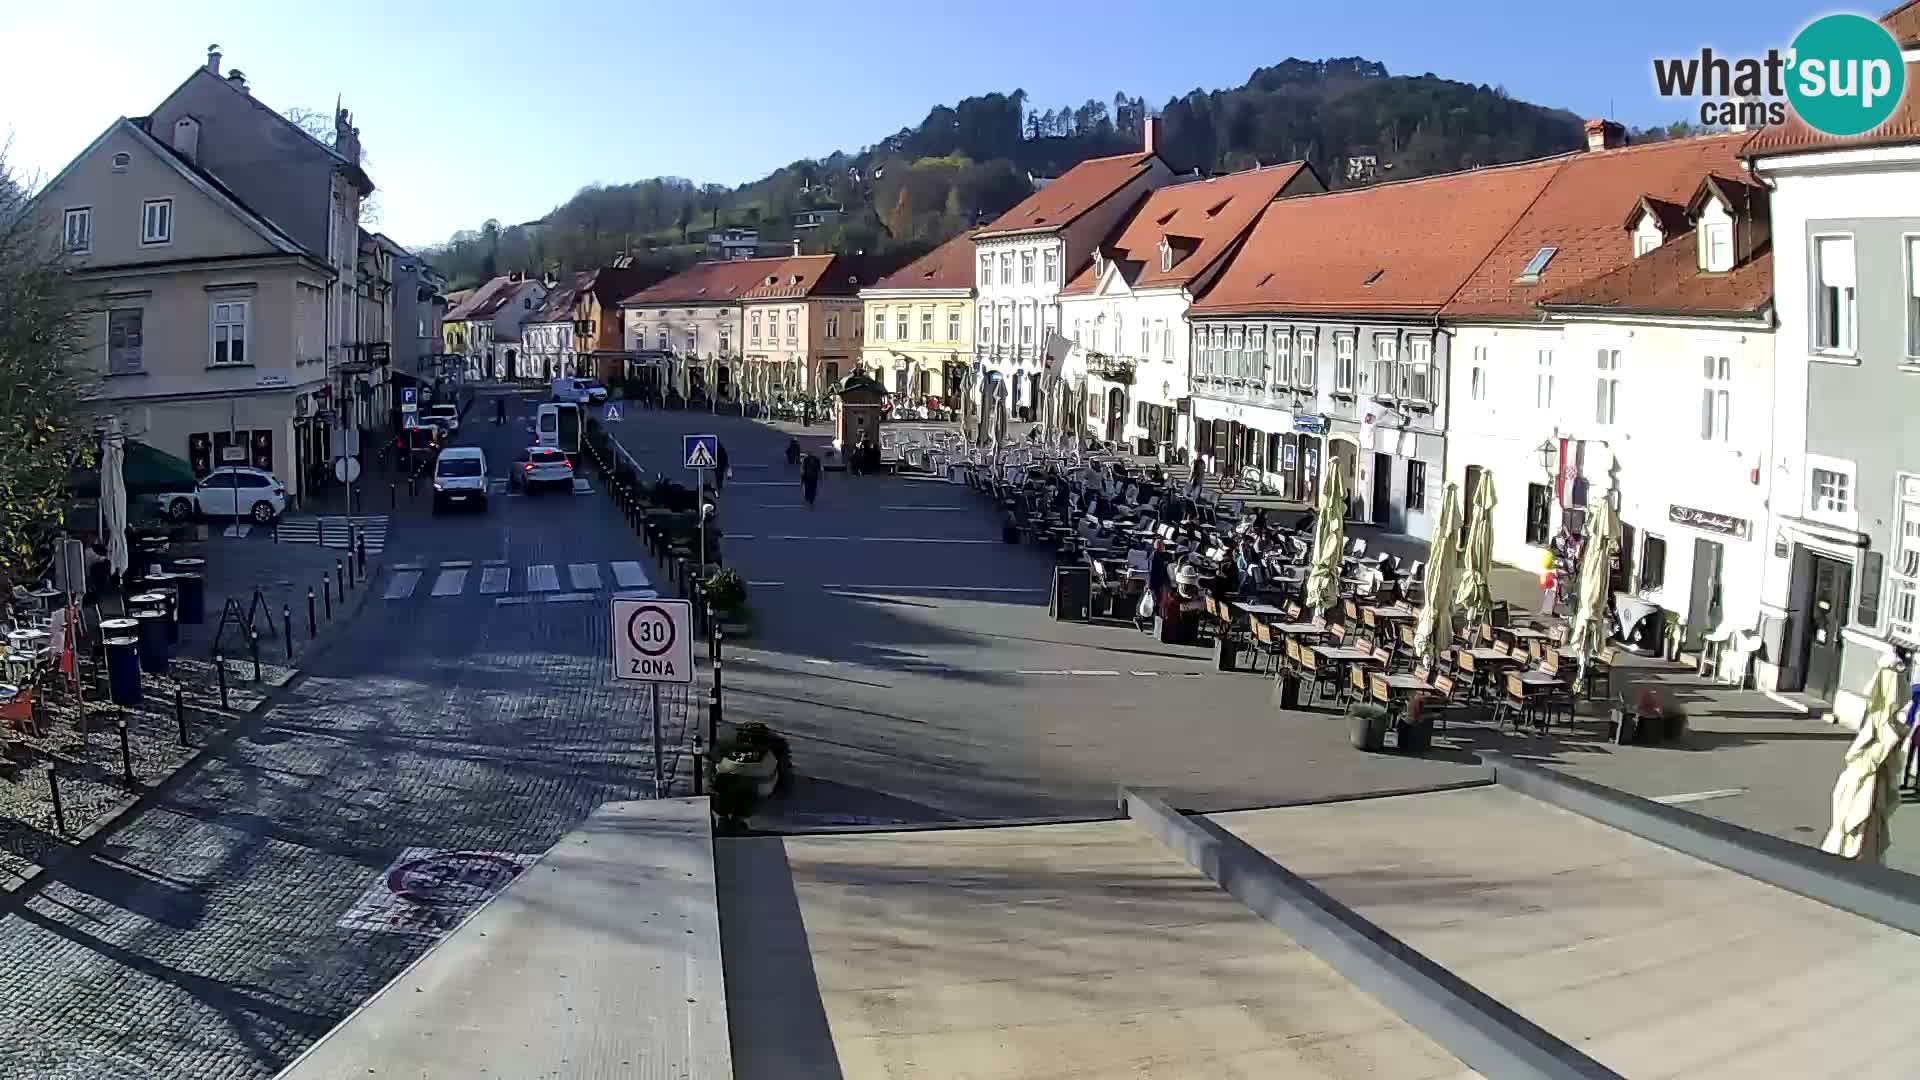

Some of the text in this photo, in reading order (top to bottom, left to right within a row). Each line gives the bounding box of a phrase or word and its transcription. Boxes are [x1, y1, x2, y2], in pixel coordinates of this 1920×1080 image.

[405, 390, 413, 402] P
[640, 621, 664, 642] 30
[631, 658, 675, 676] ZONA
